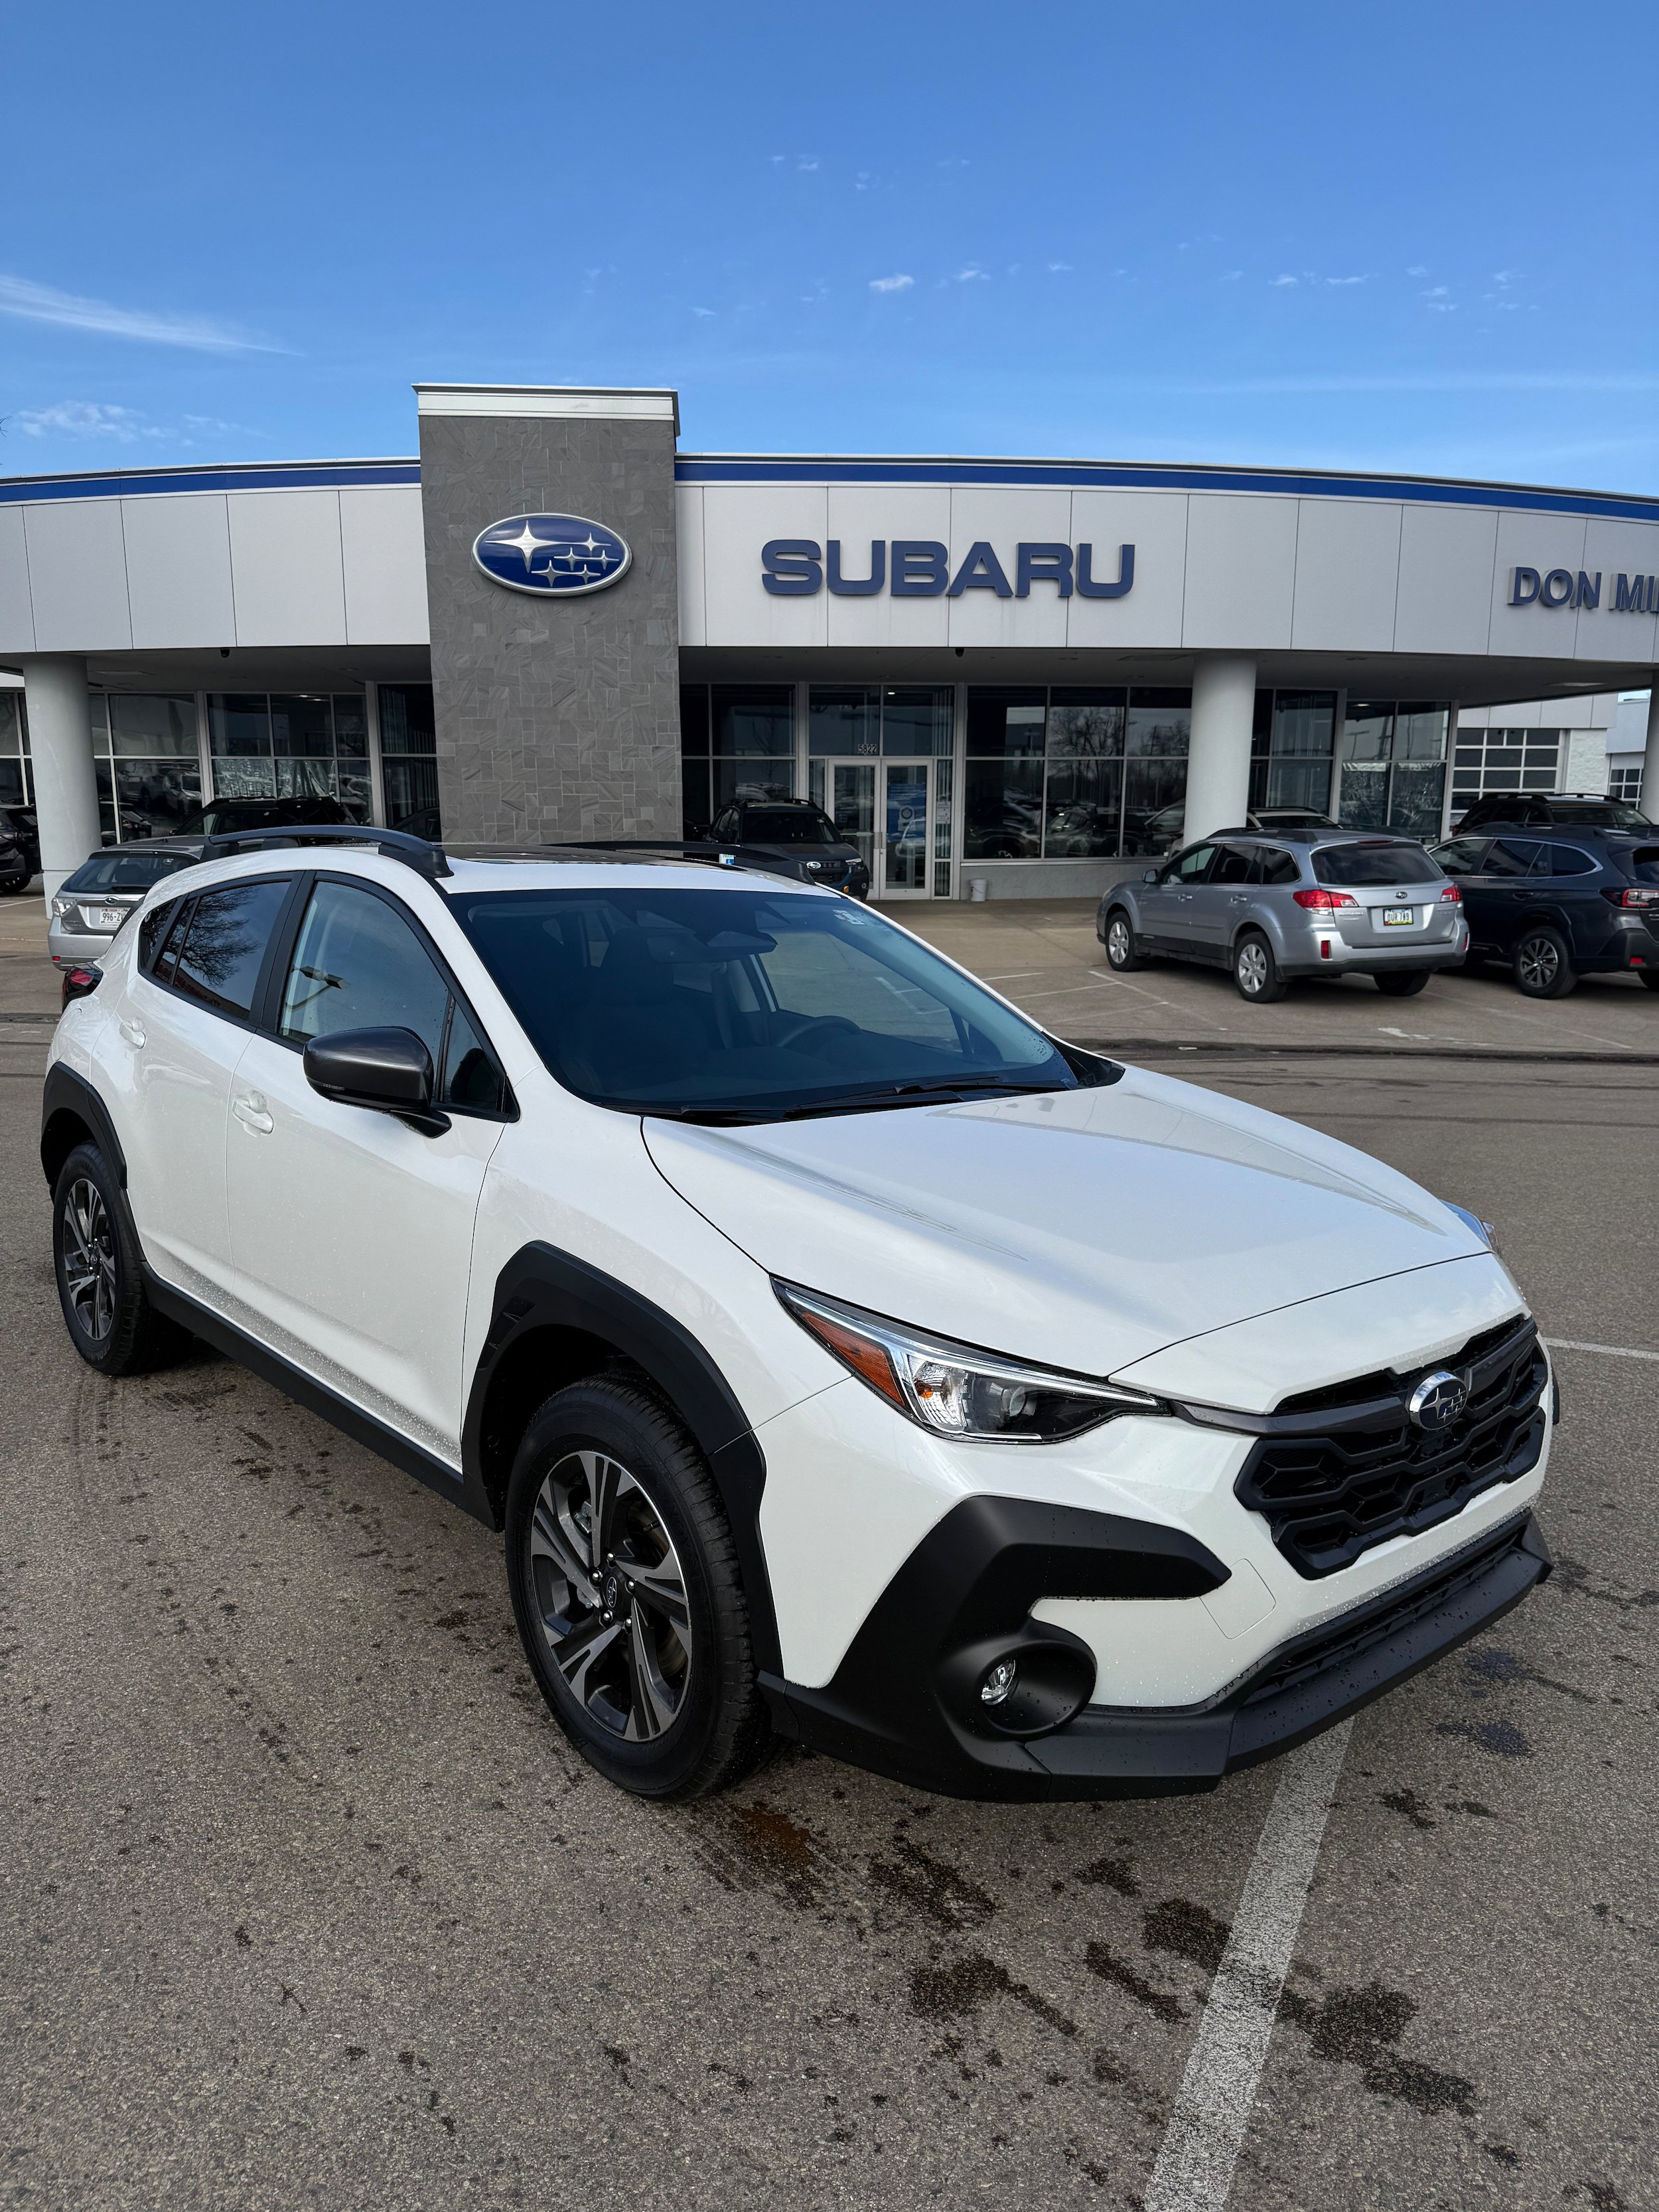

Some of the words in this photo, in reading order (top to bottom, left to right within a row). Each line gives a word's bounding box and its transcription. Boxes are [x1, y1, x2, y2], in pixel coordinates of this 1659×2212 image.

[761, 539, 1135, 598] SUBARU
[1507, 567, 1602, 609] DON
[1609, 573, 1659, 613] MI
[859, 744, 876, 753] 5822
[102, 913, 125, 921] 996-ZV
